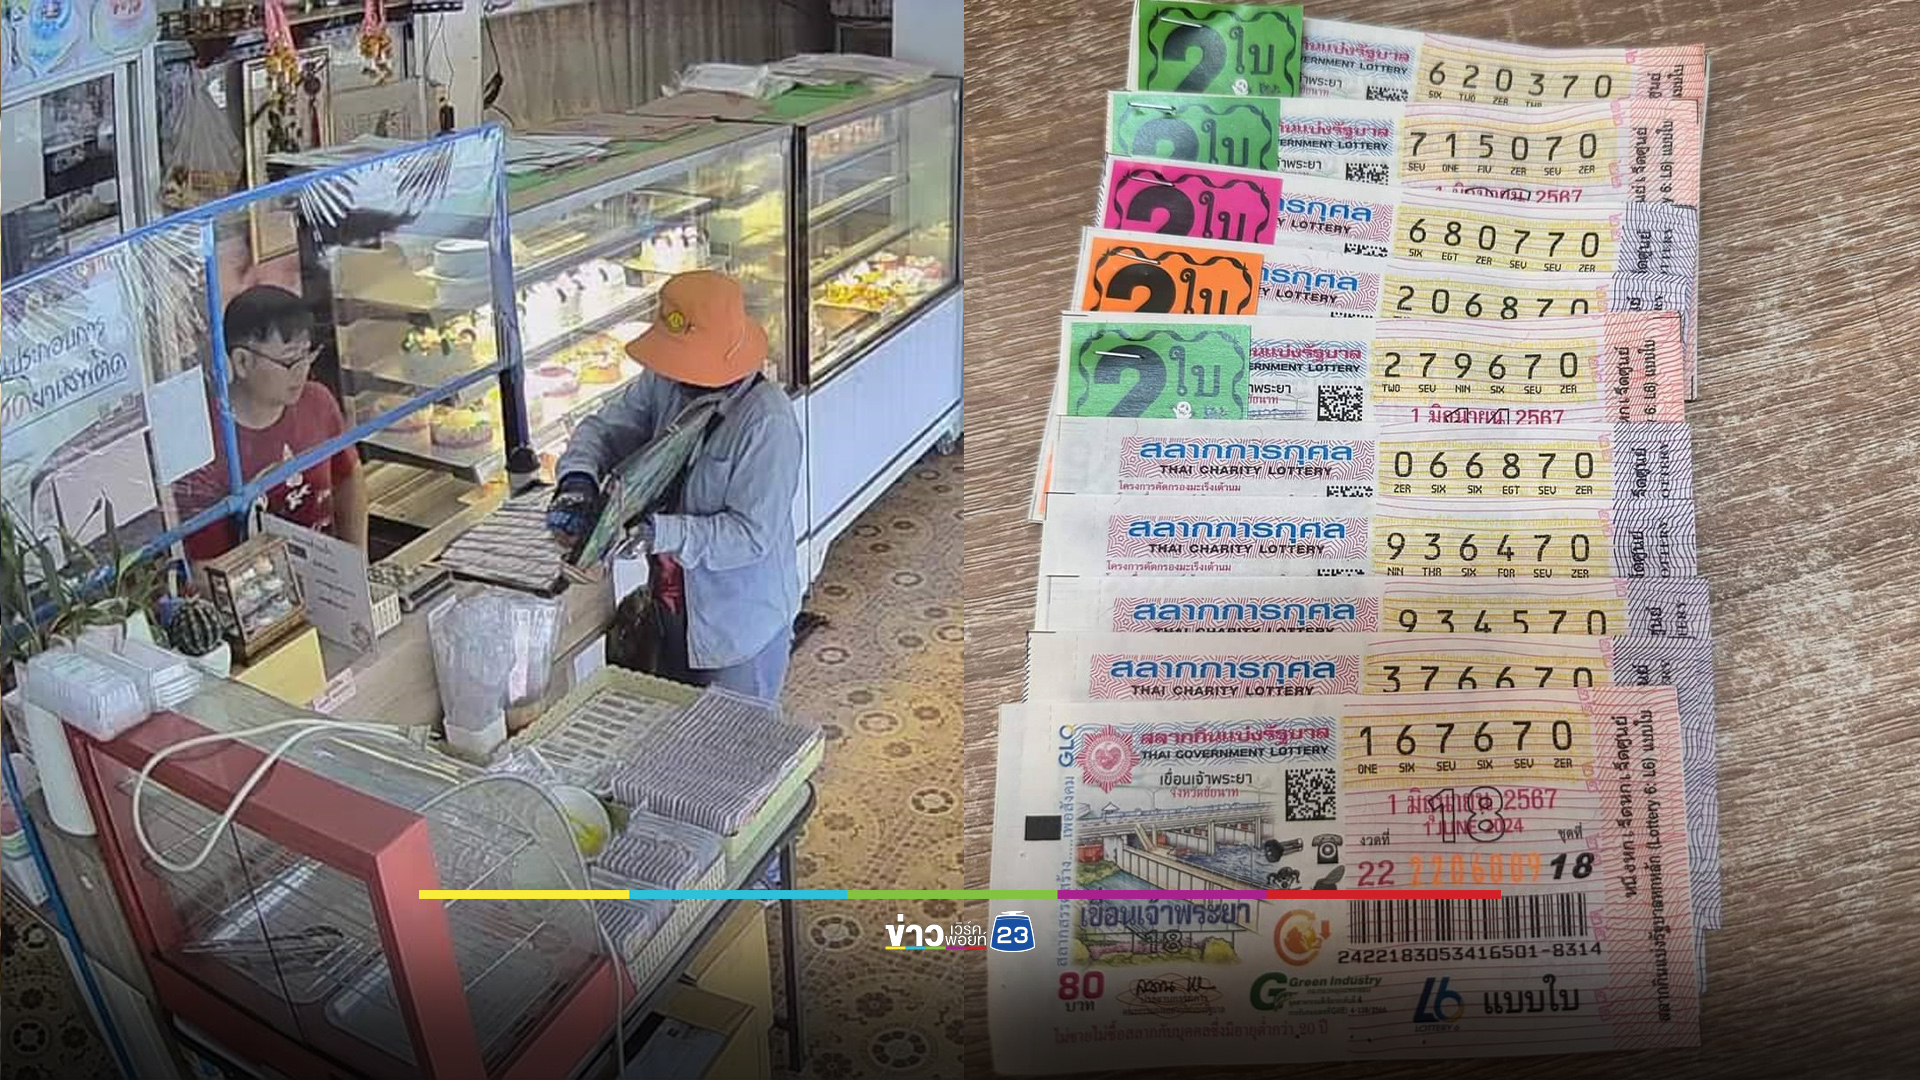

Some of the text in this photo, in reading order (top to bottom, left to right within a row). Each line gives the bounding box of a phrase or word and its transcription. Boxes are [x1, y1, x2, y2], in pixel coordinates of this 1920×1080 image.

[1162, 24, 1275, 92] 2 ใบ
[1360, 62, 1408, 76] LOTTERY
[1429, 62, 1612, 99] 620370
[1428, 90, 1442, 99] SIX
[1493, 96, 1509, 106] ZER
[1201, 118, 1249, 166] ใบ
[1279, 139, 1388, 151] ERNMENT LOTTERY
[1410, 132, 1597, 161] 715070
[1442, 164, 1459, 173] ONE
[1511, 166, 1527, 176] ZER
[1578, 165, 1595, 174] ZER
[1126, 184, 1247, 241] 2 ใบ
[1292, 220, 1351, 234] LOTTERY
[1409, 218, 1600, 258] 680770
[1409, 249, 1423, 258] SIX
[1442, 253, 1458, 262] EGT
[1476, 256, 1492, 265] ZER
[1579, 264, 1595, 273] ZER
[1106, 263, 1228, 314] 2 ใบ
[1276, 288, 1338, 304] LOTTERY
[1396, 285, 1589, 319] 206870
[1308, 363, 1360, 374] LOTTERY
[1385, 352, 1578, 380] 279670
[1093, 344, 1221, 417] 2 ใบ
[1382, 384, 1401, 393] TWO
[1455, 384, 1471, 394] NIN
[1490, 385, 1505, 395] SIX
[1560, 385, 1577, 394] ZER
[1411, 408, 1419, 423] 1
[1516, 409, 1564, 424] 2567
[1140, 440, 1353, 465] สลากการกุศล
[1159, 465, 1332, 476] THAI CHARITY LOTTERY
[1394, 451, 1594, 479] 066870
[1394, 484, 1411, 494] ZER
[1431, 484, 1446, 494] SIX
[1467, 485, 1482, 495] SIX
[1502, 485, 1520, 495] EGT
[1575, 486, 1593, 495] ZER
[1129, 520, 1346, 544] สลากการกุศล
[1150, 544, 1325, 554] THAI CHARITY LOTTERY
[1387, 532, 1590, 562] 936470
[1387, 567, 1404, 577] NIN
[1422, 568, 1442, 577] THR
[1461, 568, 1476, 577] SIX
[1498, 568, 1515, 578] FOR
[1571, 569, 1589, 578] ZER
[1133, 601, 1355, 625] สลากการกุศล
[1399, 609, 1607, 635] 934570
[1110, 660, 1335, 684] สลากการกุศล
[1382, 666, 1593, 692] 376670
[1132, 685, 1314, 696] THAI CHARITY LOTTERY
[1140, 724, 1330, 747] สลากกินแบ่งรัฐบาล
[1360, 720, 1572, 756] 167670
[1633, 710, 1654, 752] แบบใบ
[1058, 724, 1076, 768] GLO
[1142, 745, 1329, 760] THAI GOVERNMENT LOTTERY
[1160, 768, 1252, 786] เขื่อนเจ้าพระยา
[1358, 764, 1378, 775] ONE
[1399, 763, 1415, 773] SIX
[1477, 760, 1493, 770] SIX
[1554, 758, 1573, 769] ZER
[1171, 787, 1239, 798] จังหวัดชัยนาท
[1389, 795, 1396, 815] 1
[1505, 788, 1558, 811] 2567
[1429, 785, 1505, 844] 18
[1437, 820, 1477, 835] JUNE
[1487, 818, 1525, 834] 2024
[1646, 800, 1662, 849] (Lottery
[1360, 828, 1390, 846] งวดที่
[1558, 824, 1583, 843] ชุดที่
[1358, 852, 1595, 887] 22 2206009 18
[1338, 941, 1602, 965] 2422183053416501-8314
[1058, 971, 1105, 1000] 80
[1289, 975, 1383, 988] Green Industry
[1484, 973, 1579, 1015] แบบใบ
[1065, 1001, 1095, 1012] บาท
[1299, 1021, 1315, 1035] 20
[1319, 1018, 1329, 1035] ปี
[1415, 1025, 1450, 1033] LOTTERY
